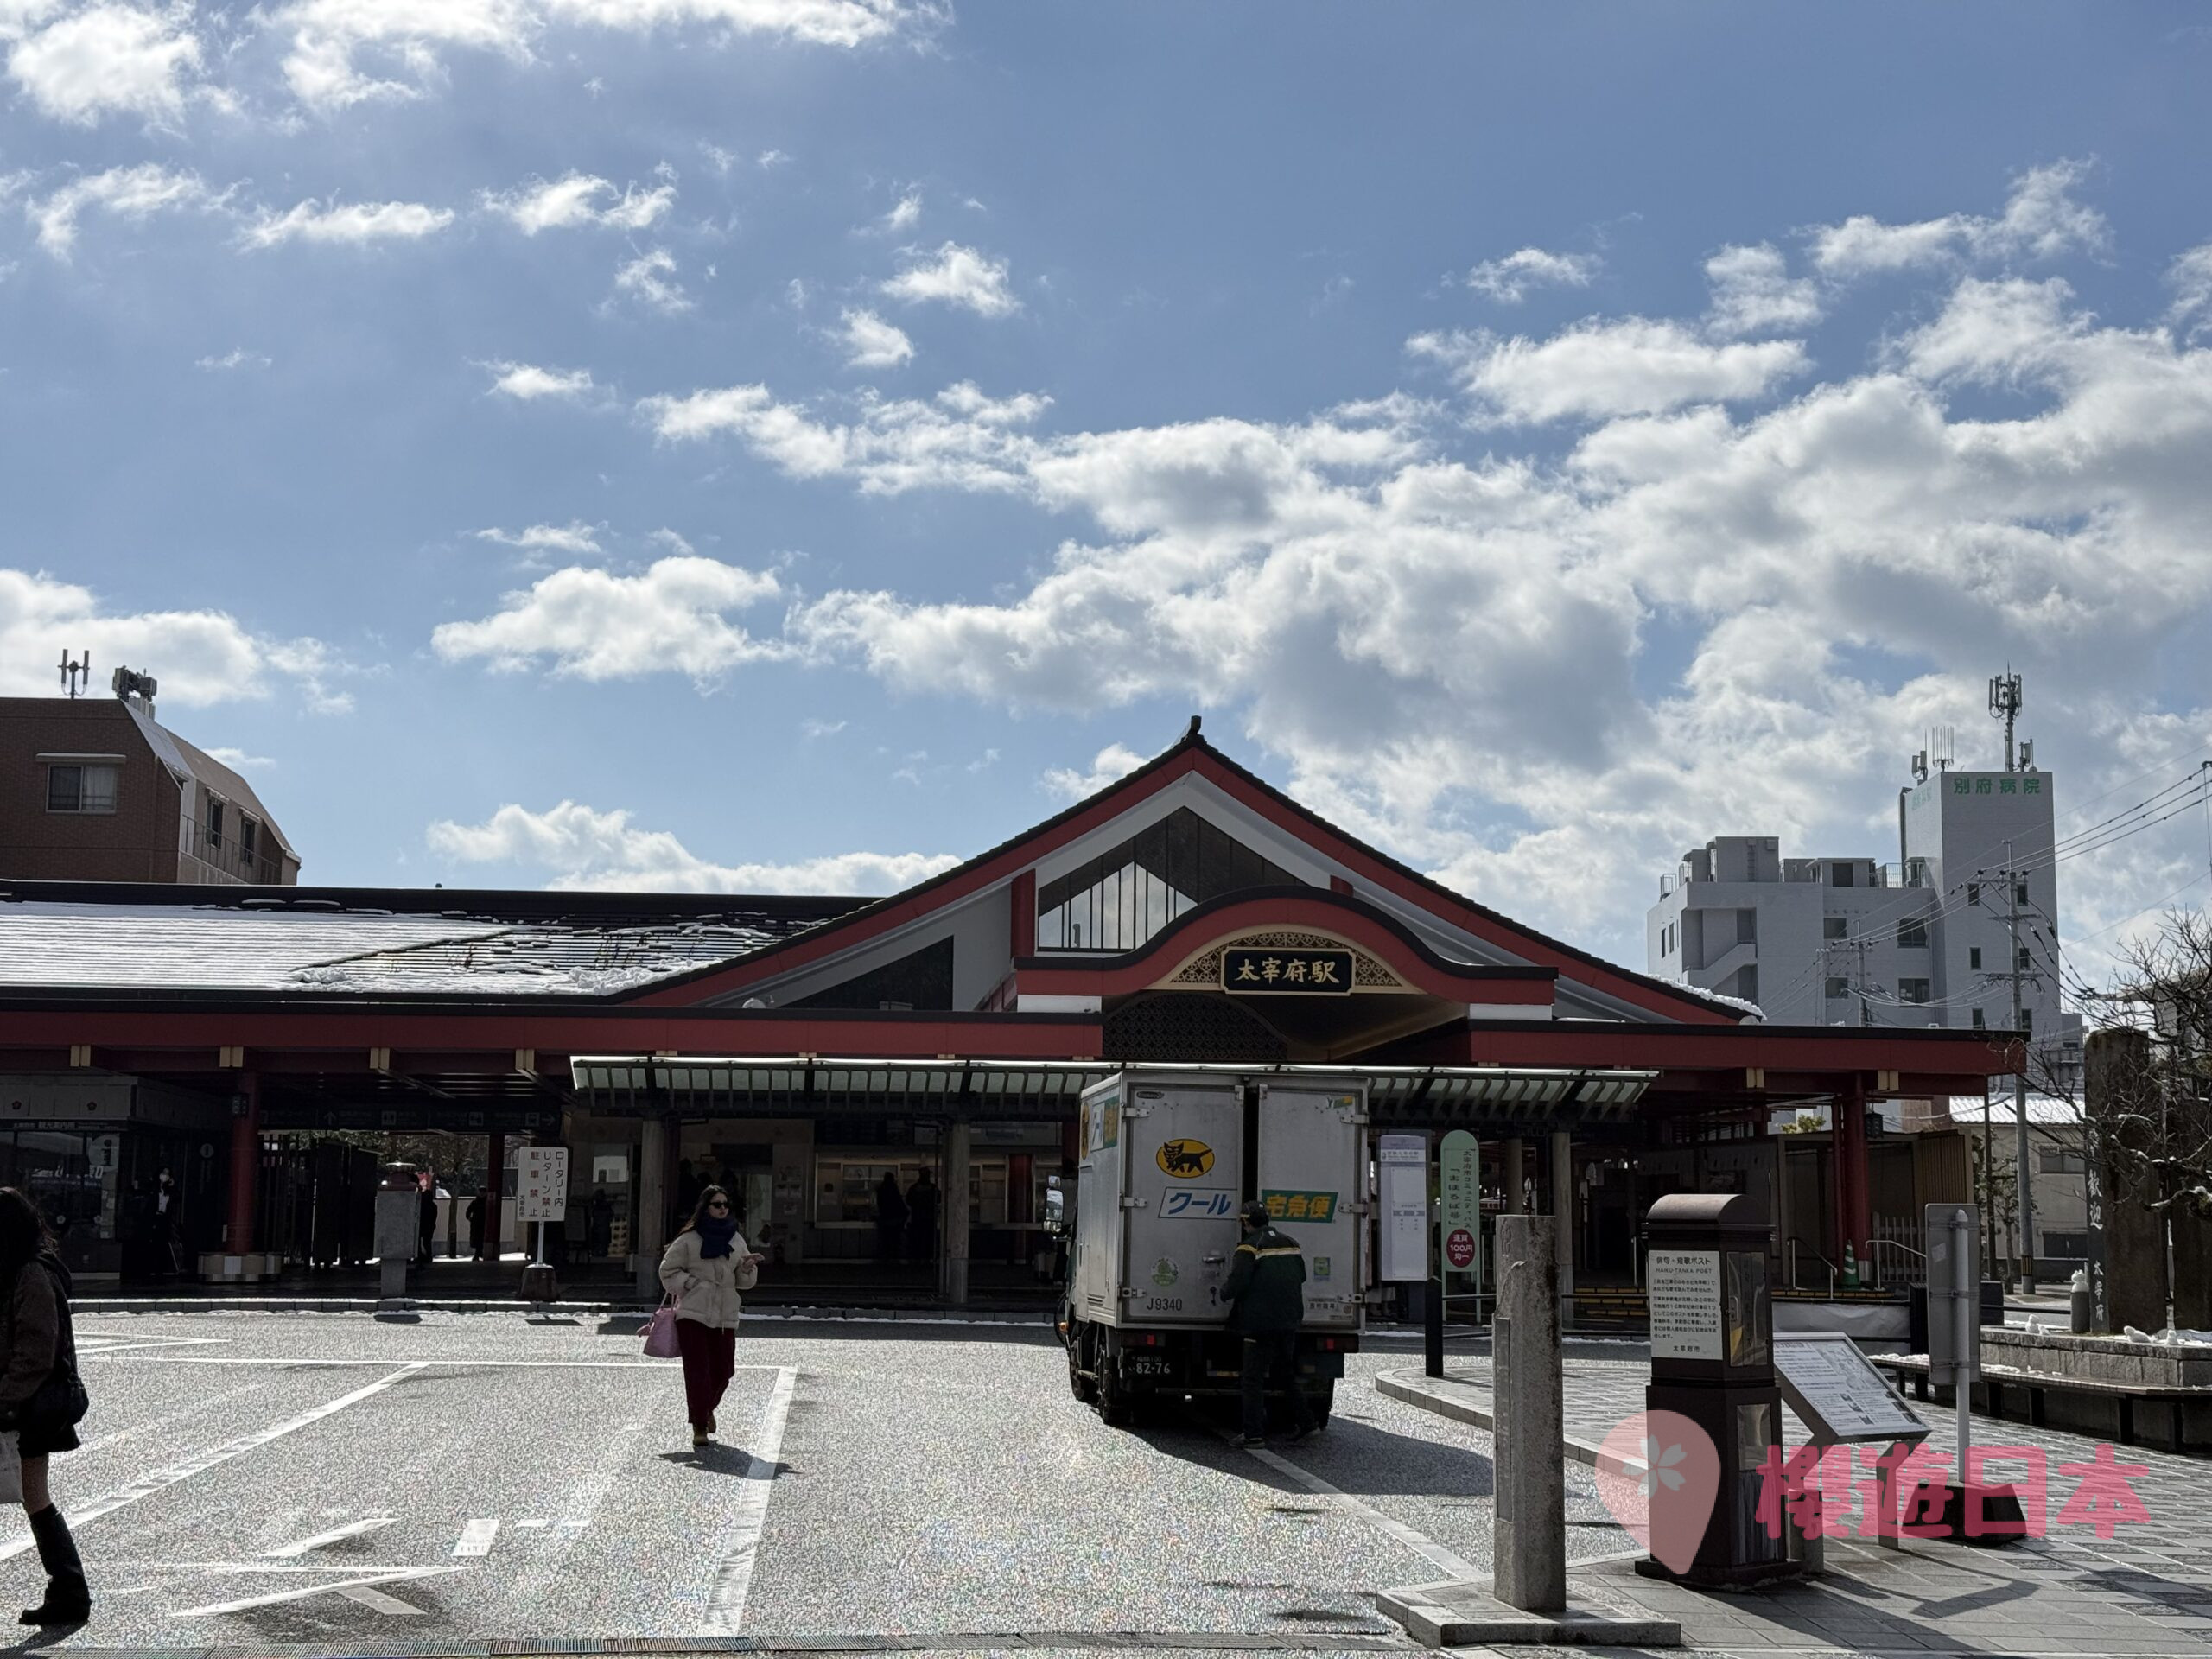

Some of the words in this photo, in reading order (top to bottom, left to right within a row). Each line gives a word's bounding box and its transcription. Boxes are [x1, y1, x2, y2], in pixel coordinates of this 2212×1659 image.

[1954, 777, 2041, 795] 別府病院
[1234, 956, 1340, 985] 太宰府駅
[529, 1151, 539, 1217] 駐車禁止
[541, 1151, 552, 1217] Uターン禁止
[554, 1151, 564, 1207] ロータリー内
[1167, 1192, 1231, 1215] クール
[1266, 1193, 1332, 1218] 宅急便
[1449, 1244, 1473, 1253] 100円
[1147, 1297, 1183, 1312] J9340
[1136, 1362, 1172, 1375] 82-76
